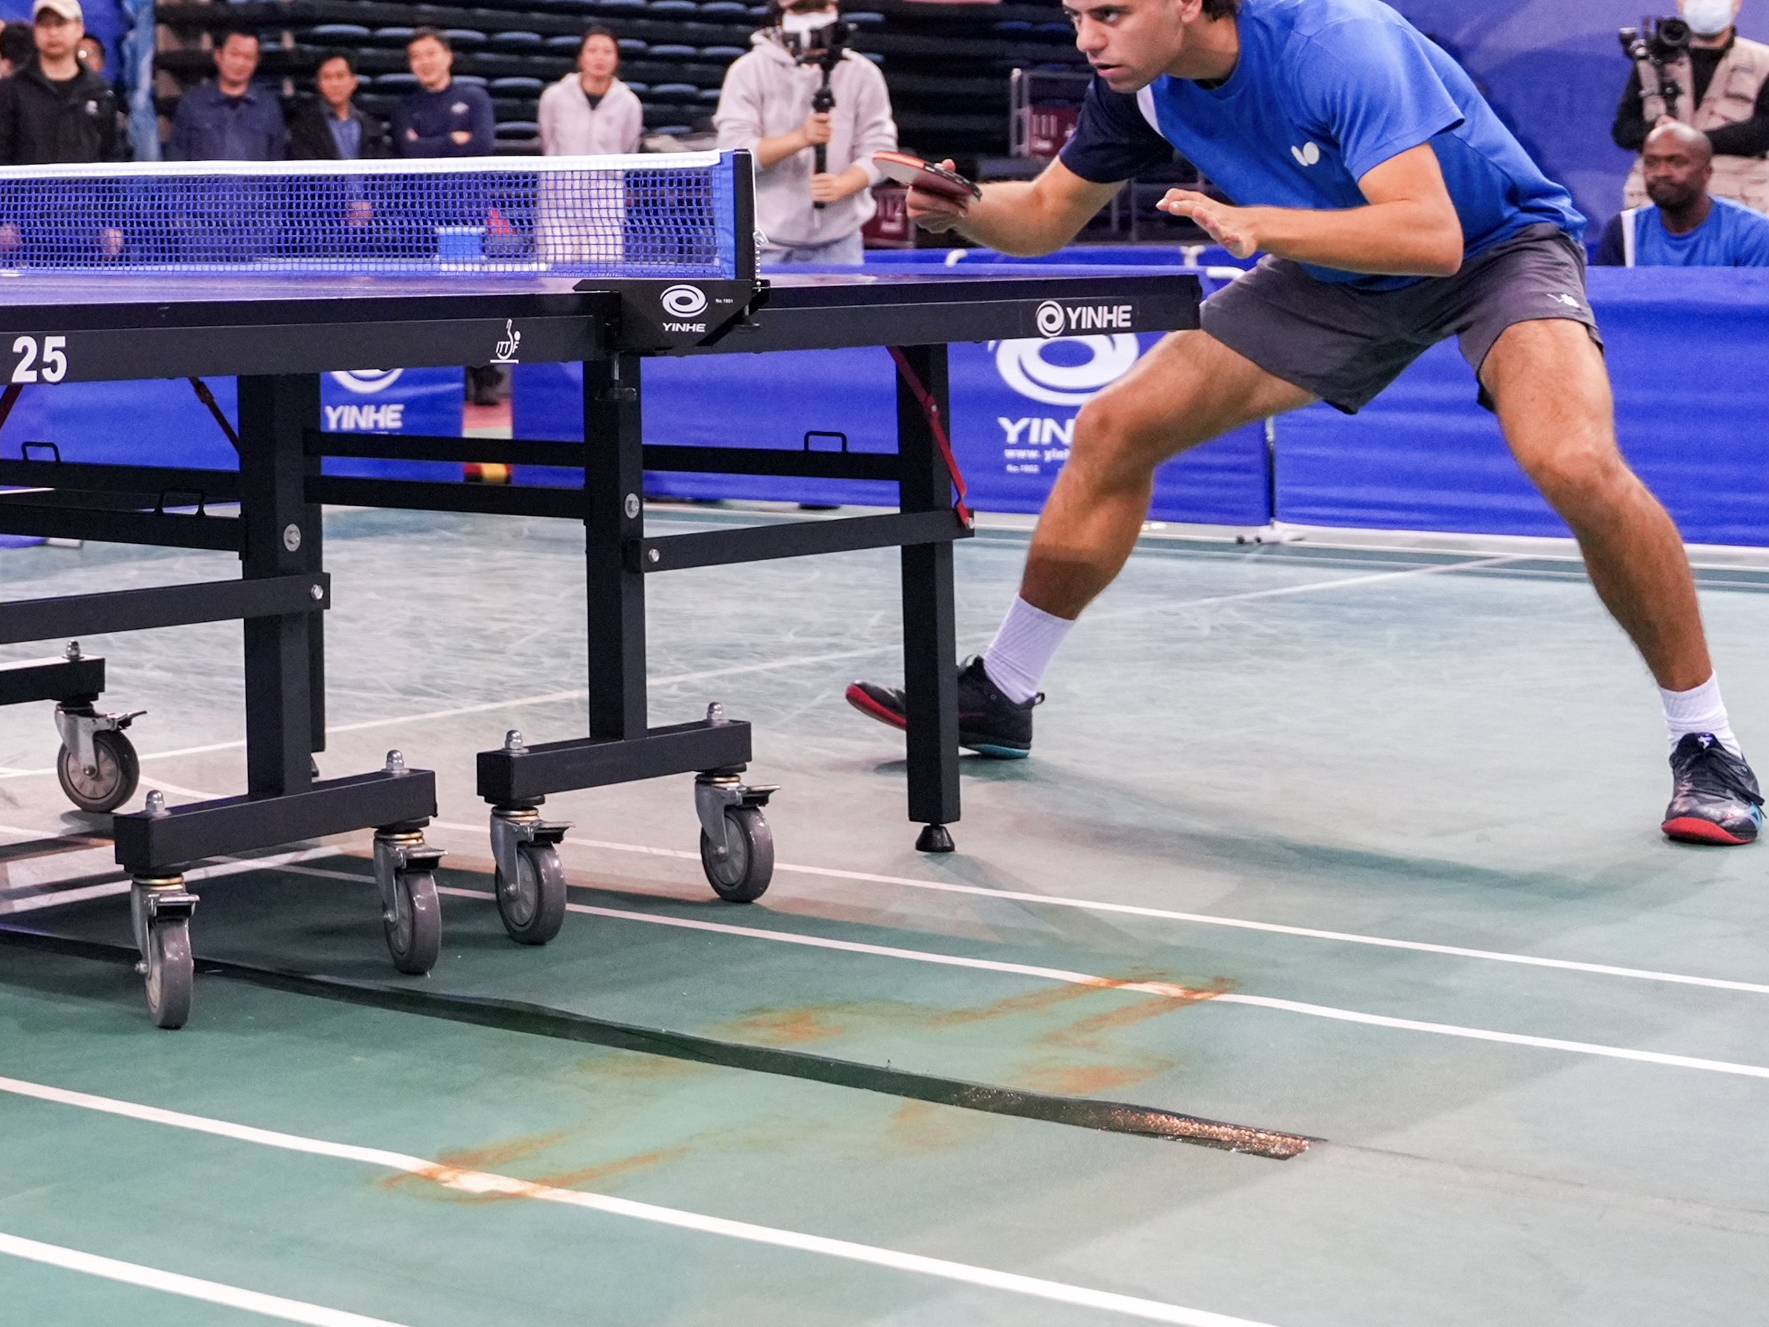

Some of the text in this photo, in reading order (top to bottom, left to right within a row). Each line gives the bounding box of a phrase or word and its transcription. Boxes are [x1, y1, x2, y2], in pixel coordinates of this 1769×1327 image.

[662, 323, 706, 333] YINHE
[1066, 305, 1132, 330] YINHE
[11, 335, 67, 383] 25
[325, 404, 405, 431] YINHE
[997, 417, 1076, 445] YIN
